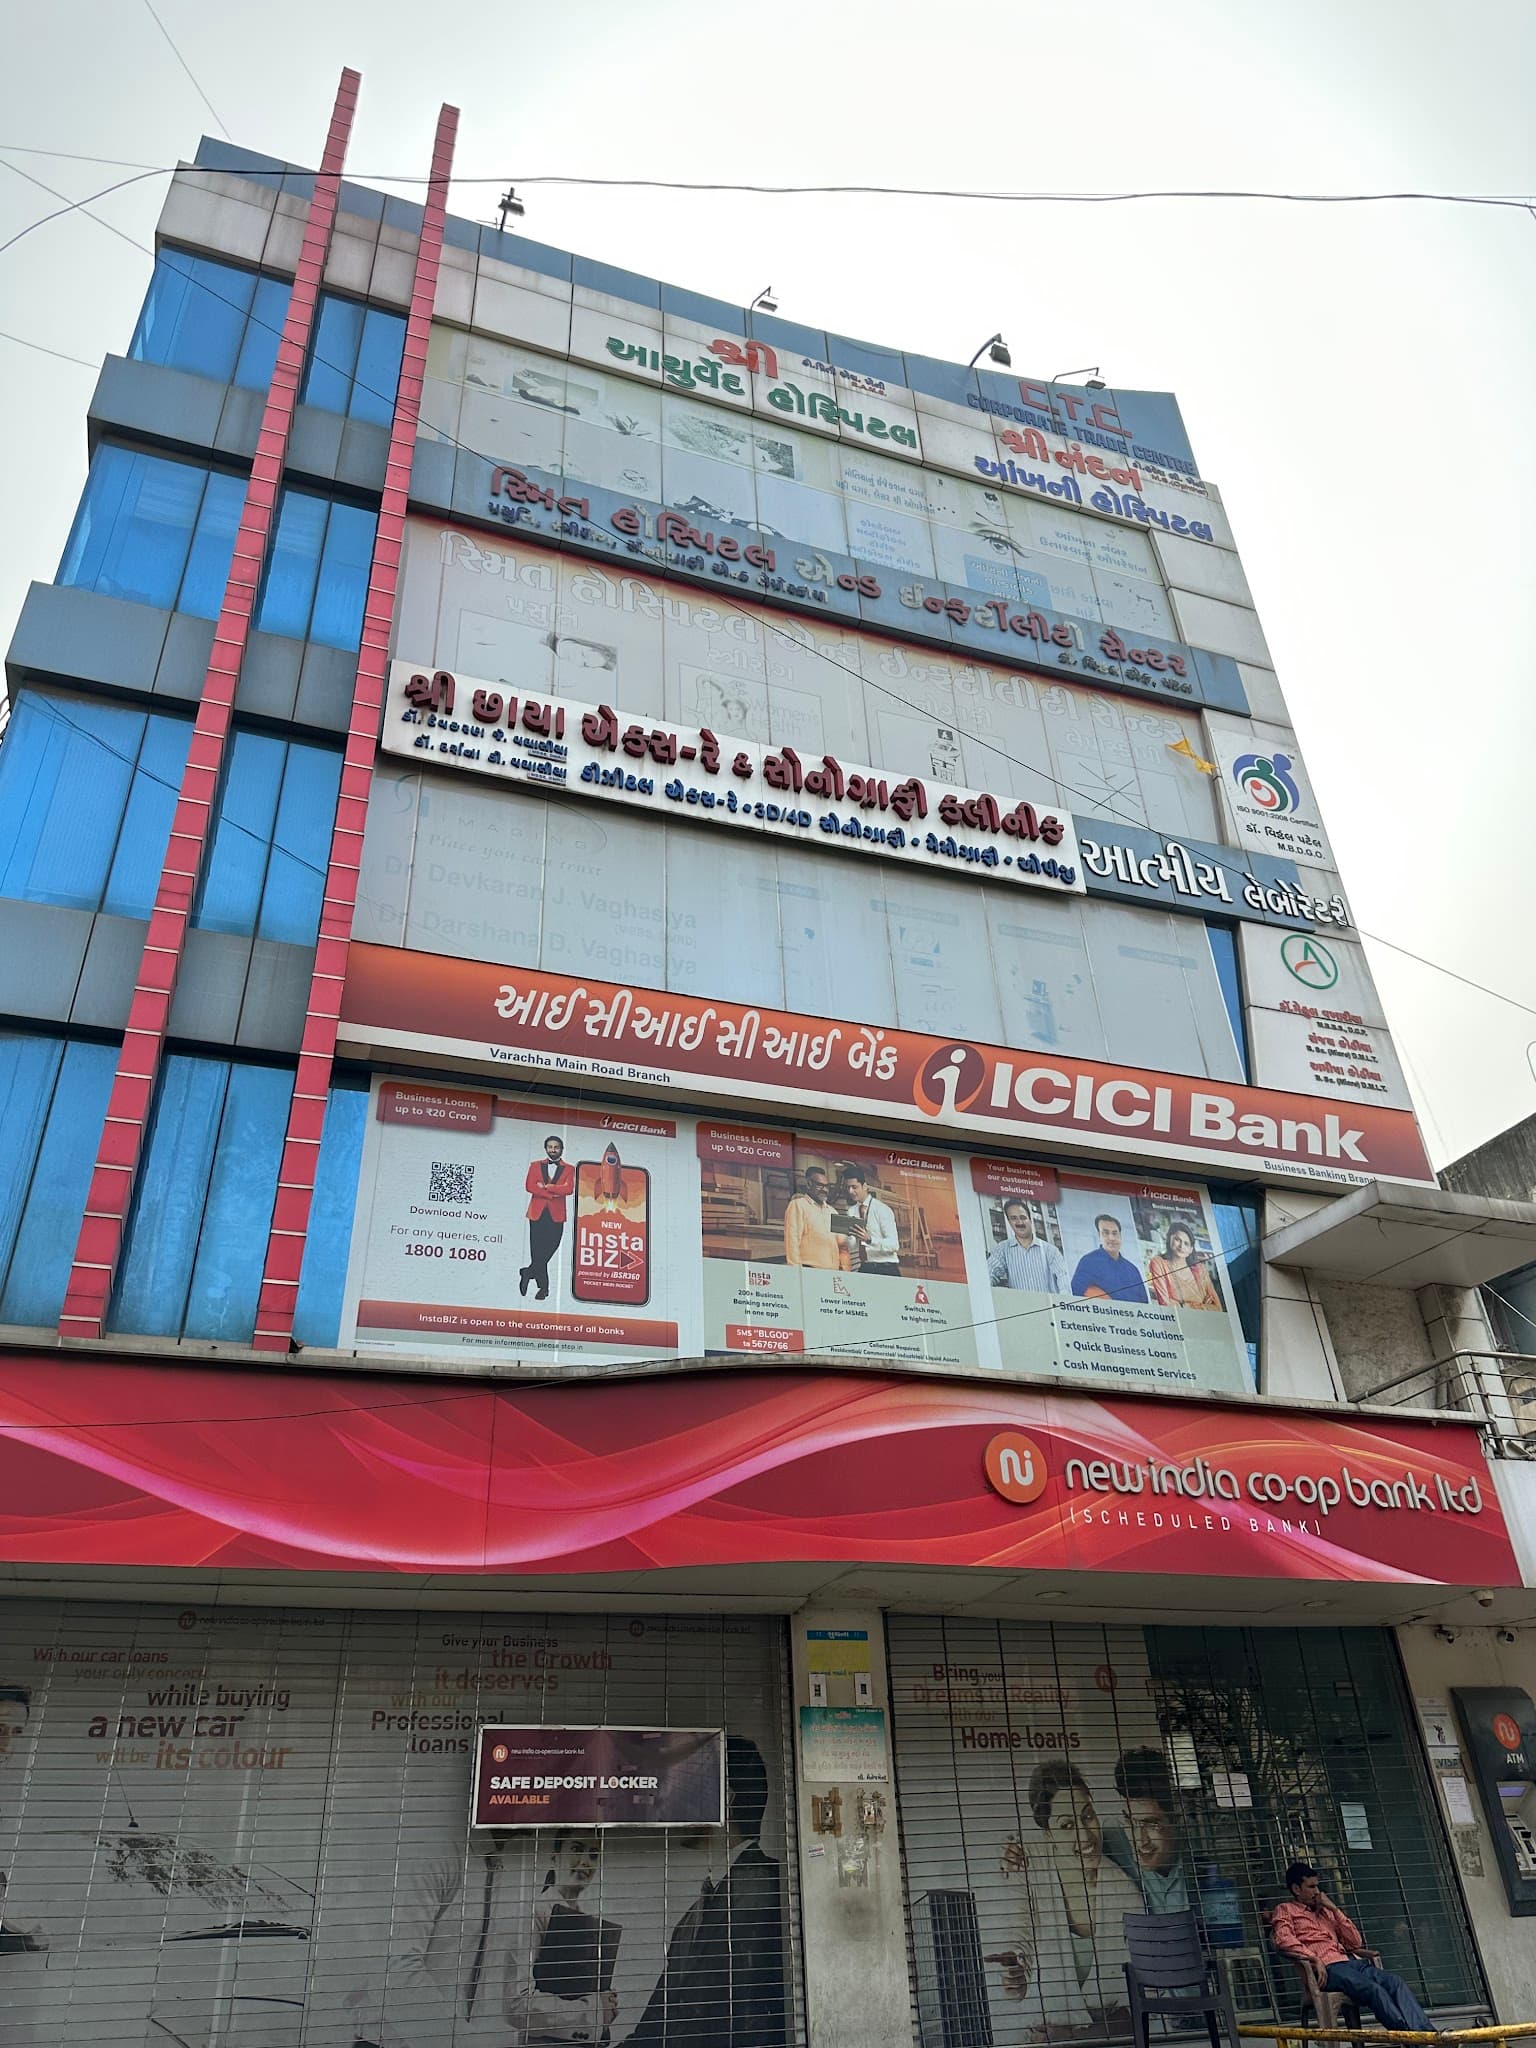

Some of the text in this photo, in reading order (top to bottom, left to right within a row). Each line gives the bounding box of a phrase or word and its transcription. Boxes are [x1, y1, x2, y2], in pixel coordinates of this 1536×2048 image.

[708, 339, 778, 379] શ્રી
[606, 336, 745, 396] આયુર્વેદ
[767, 382, 917, 449] હોસ્પિટલ
[967, 394, 1195, 475] CORPORATE TRADE CENTRE
[974, 456, 1082, 503] આંખની
[1090, 485, 1214, 542] હોસ્પિટલ
[491, 466, 589, 519] સ્મિત
[612, 502, 775, 571] હોસ્પિટલ
[404, 670, 455, 715] શ્રી
[472, 688, 565, 740] છાયા
[732, 752, 754, 780] &
[763, 747, 928, 822] સોનોગ્રાફી
[1237, 805, 1250, 816] ISO
[754, 802, 812, 828] 3D/4D
[819, 813, 905, 850] સોનોગ્રાફી
[926, 832, 999, 868] મેમોગ્રાફી
[1297, 831, 1322, 848] પટેલ
[1081, 840, 1233, 904] આત્મીય
[489, 1047, 671, 1083] Varachha Main Road Branch
[847, 1028, 898, 1081] બેંક
[395, 1091, 479, 1111] Business Loans,
[395, 1106, 478, 1122] up to ₹20 Crore
[990, 1062, 1370, 1163] ICICI Bank
[612, 1121, 668, 1136] ICICI Bank
[710, 1130, 781, 1148] Business Loans,
[711, 1144, 781, 1158] up to ₹20 Crore
[897, 1157, 944, 1170] ICICI Bank
[987, 1163, 1005, 1172] Your
[1264, 1160, 1306, 1177] Business
[1308, 1166, 1347, 1185] Banking
[1000, 1184, 1034, 1196] solutions
[1001, 1175, 1044, 1187] customised
[409, 1205, 488, 1221] Download Now
[390, 1225, 504, 1245] For any queries, call
[601, 1221, 623, 1230] NEW
[580, 1227, 645, 1252] Insta
[404, 1243, 487, 1262] 1800 1080
[580, 1247, 620, 1269] BIZ
[748, 1270, 771, 1280] Insta
[733, 1298, 760, 1310] Banking
[744, 1309, 750, 1317] in
[765, 1311, 779, 1320] app
[1059, 1301, 1176, 1322] Smart Business Account
[419, 1313, 625, 1336] InstaBIZ is open to the customers of all banks
[736, 1328, 752, 1337] SMS
[1060, 1320, 1184, 1342] Extensive Trade Solutions
[462, 1336, 475, 1345] For
[538, 1341, 560, 1351] please
[751, 1340, 788, 1350] 5676766
[1073, 1341, 1177, 1360] Quick Business Loans
[1063, 1359, 1197, 1381] Cash Management Services
[1065, 1456, 1483, 1516] new india co-op bank ltd
[1070, 1507, 1322, 1536] (SCHEDULED BANK)
[442, 1633, 469, 1648] Give
[503, 1634, 558, 1649] Business
[492, 1648, 613, 1670] the Growth
[434, 1668, 559, 1692] it deserves
[933, 1663, 979, 1687] Bring
[148, 1684, 290, 1711] while buying
[88, 1713, 246, 1739] a new car
[412, 1734, 469, 1755] loans
[961, 1726, 1080, 1750] Home loans
[155, 1741, 292, 1770] its colour
[1506, 1753, 1525, 1765] ATM
[490, 1776, 658, 1790] SAFE DEPOSIT LOCKER
[489, 1795, 549, 1805] AVAILABLE
